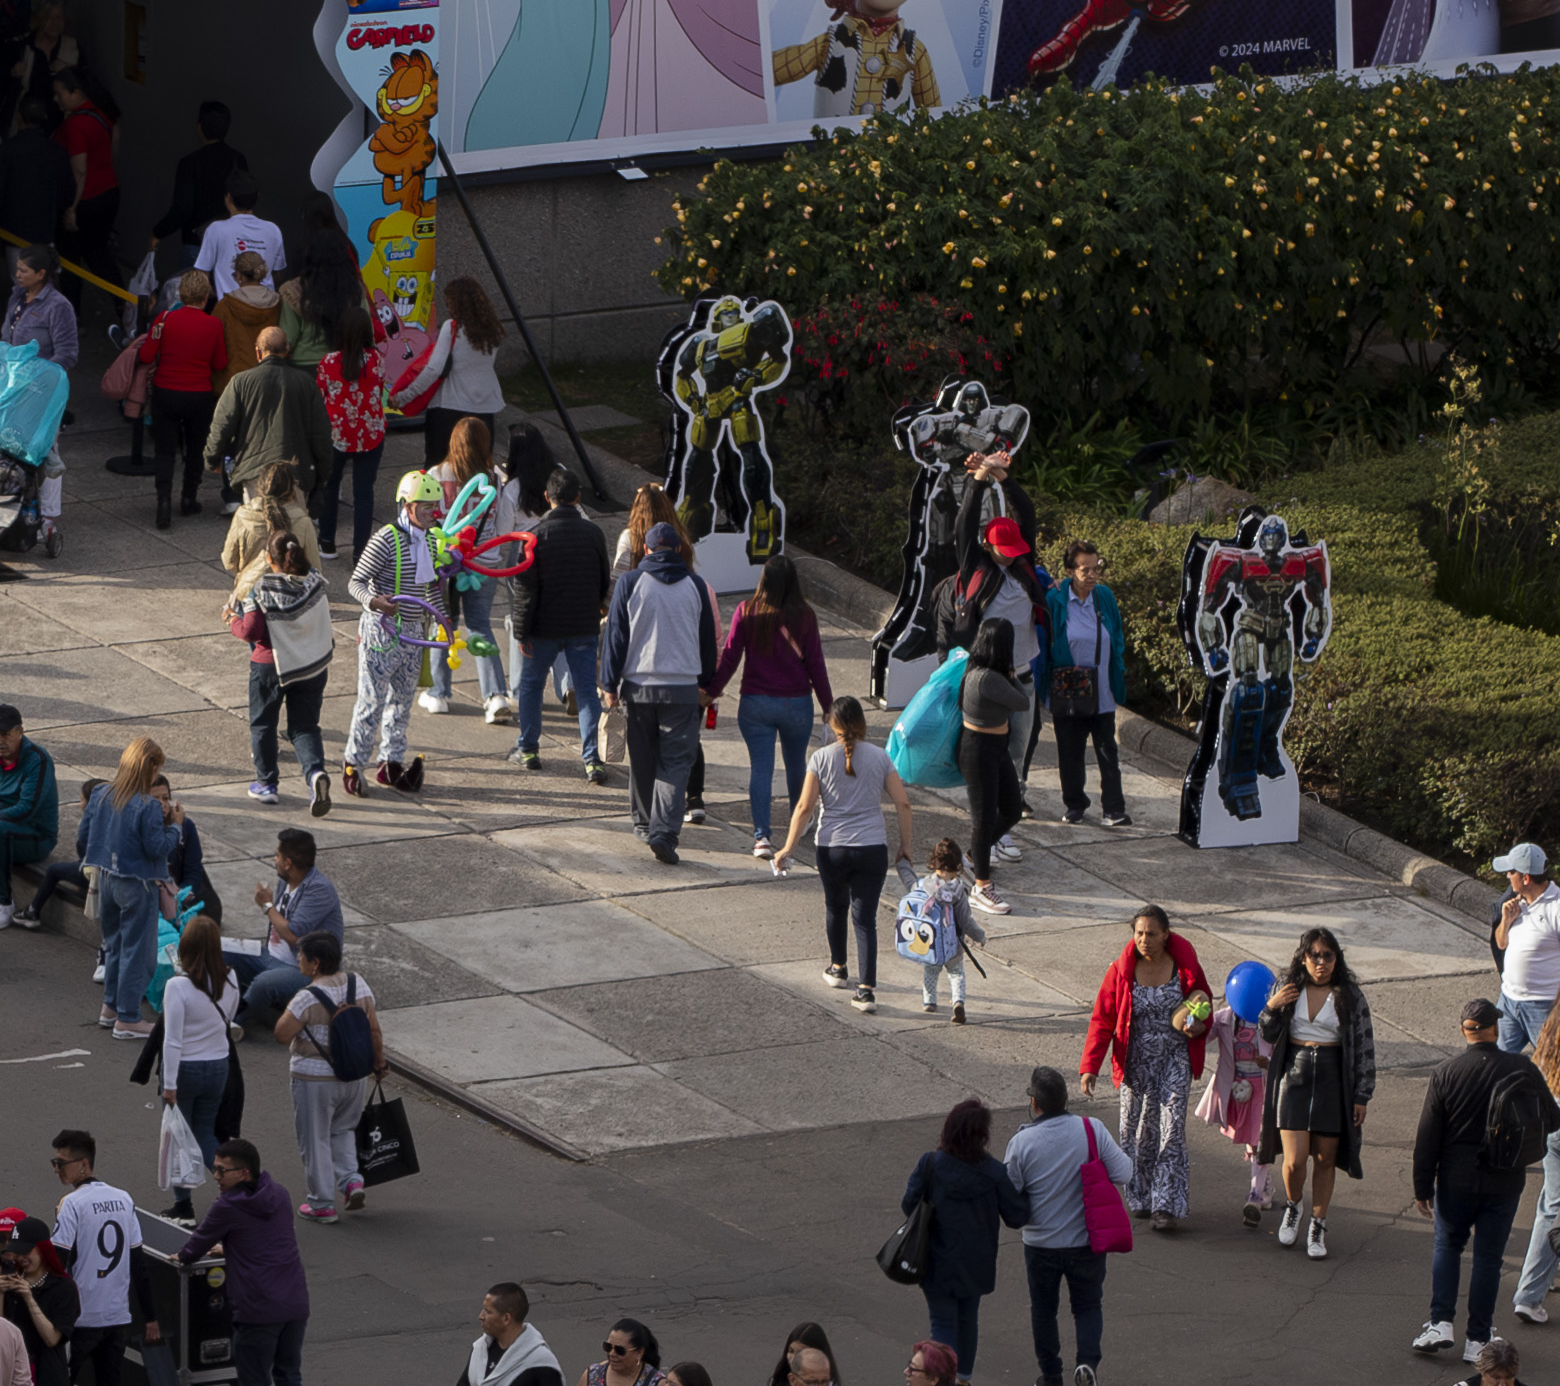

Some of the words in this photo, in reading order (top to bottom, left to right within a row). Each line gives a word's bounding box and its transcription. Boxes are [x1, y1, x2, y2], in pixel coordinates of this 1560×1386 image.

[1231, 43, 1257, 56] 2024
[1260, 37, 1311, 53] MARVEL
[97, 1220, 125, 1278] 9
